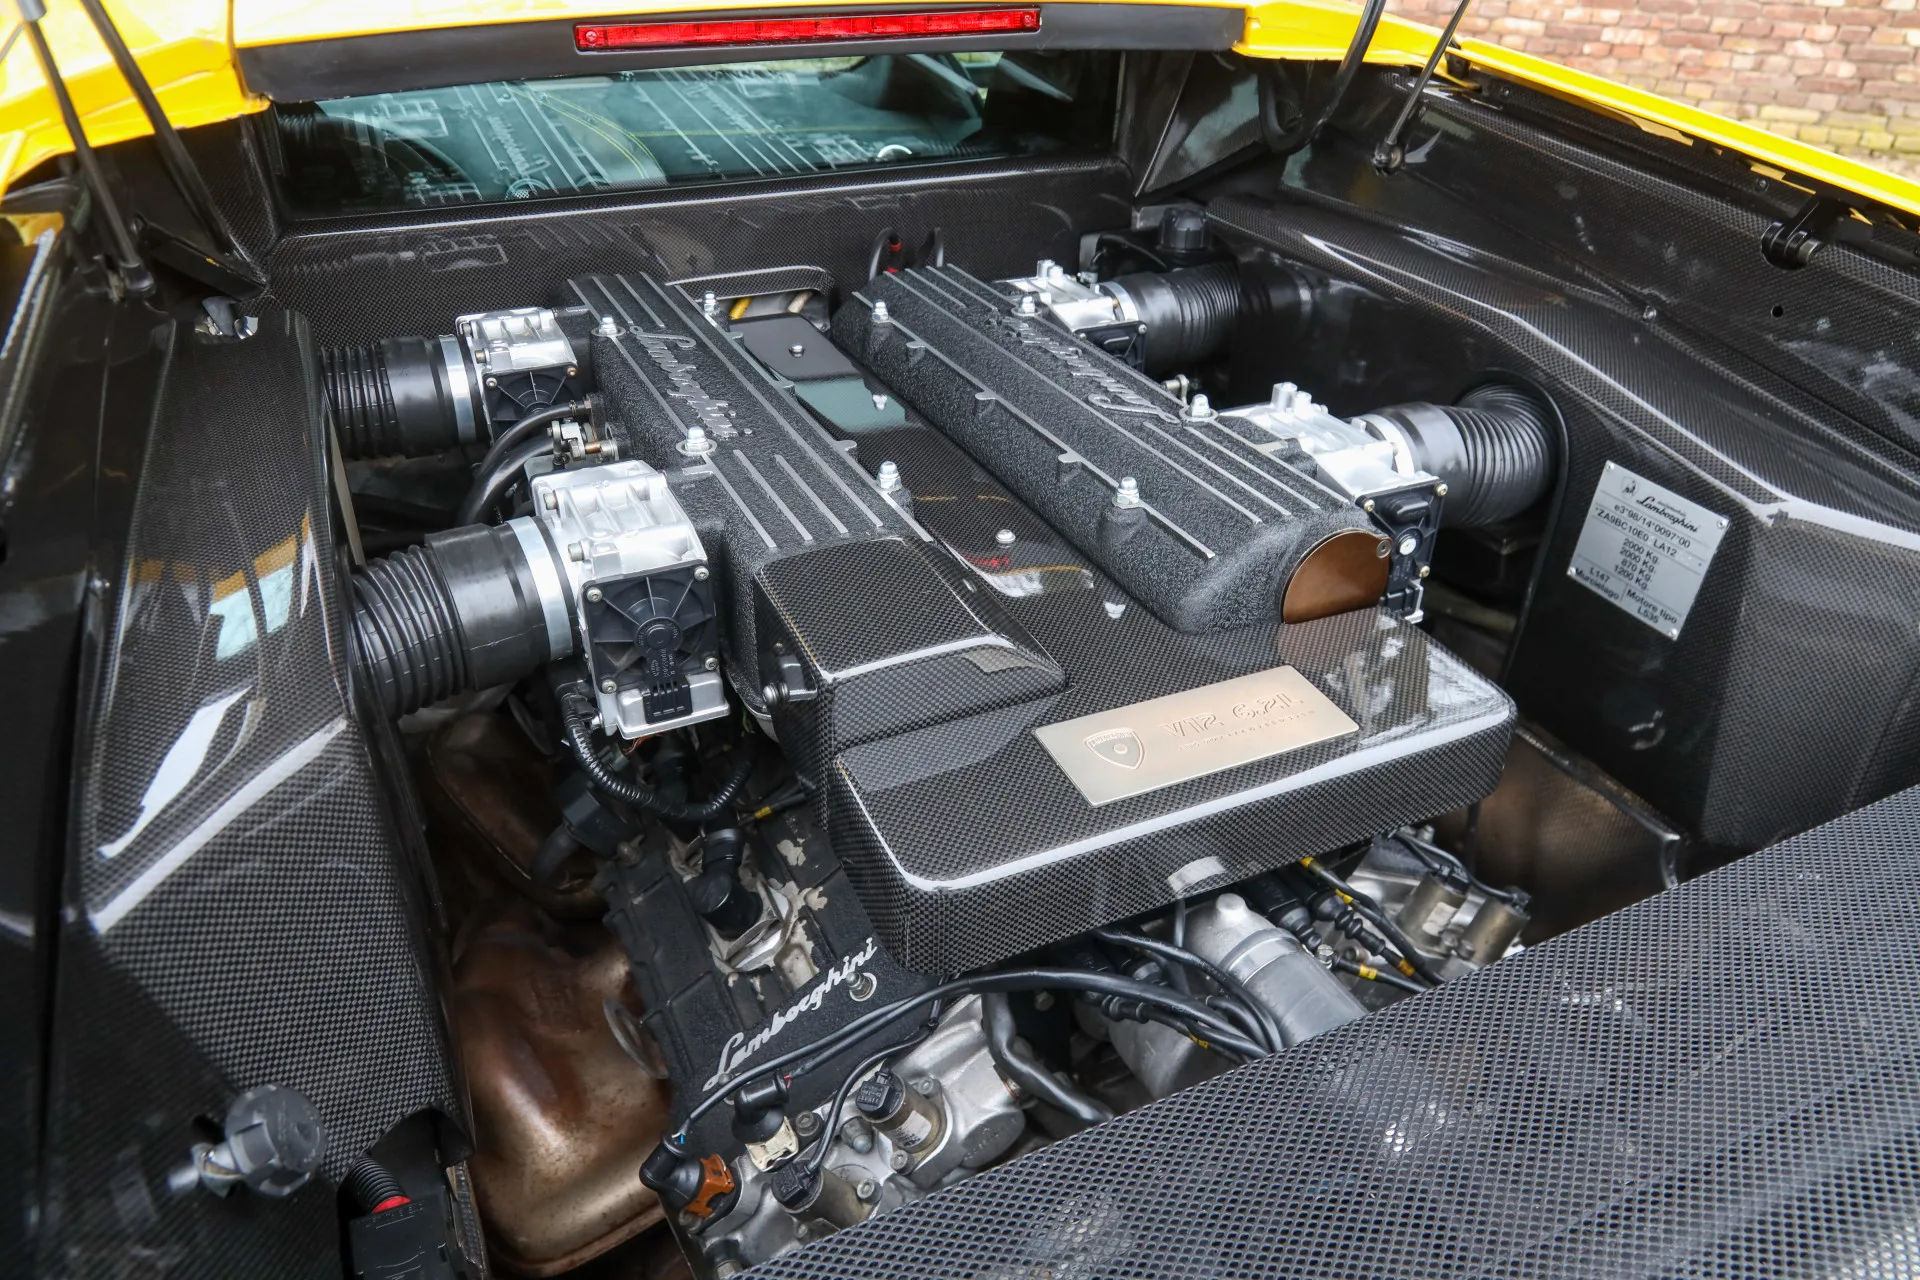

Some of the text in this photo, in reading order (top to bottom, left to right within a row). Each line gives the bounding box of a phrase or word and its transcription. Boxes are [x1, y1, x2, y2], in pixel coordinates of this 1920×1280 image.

[629, 325, 753, 440] Lamborghini
[1636, 495, 1699, 533] Lamborghini
[1619, 546, 1641, 564] 2000
[1622, 538, 1645, 555] 2000
[1589, 566, 1611, 583] L147
[1613, 564, 1634, 581] 1200
[1626, 588, 1678, 624] Motore tipo
[1637, 605, 1659, 624] L535
[1158, 711, 1224, 738] V12
[702, 937, 878, 1092] Lamborghini
